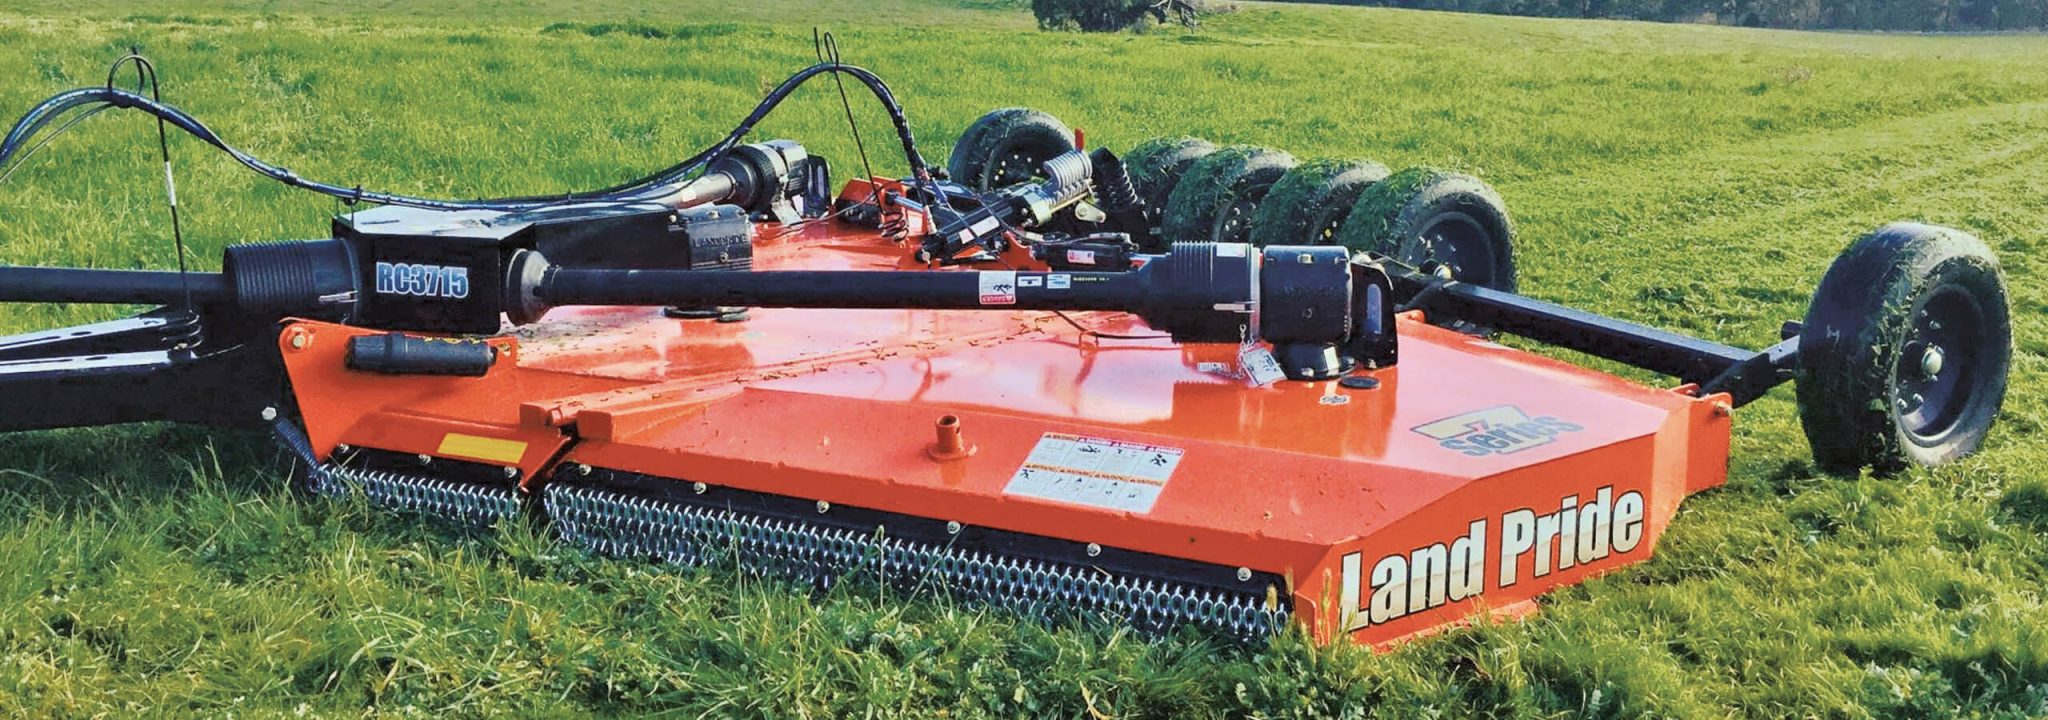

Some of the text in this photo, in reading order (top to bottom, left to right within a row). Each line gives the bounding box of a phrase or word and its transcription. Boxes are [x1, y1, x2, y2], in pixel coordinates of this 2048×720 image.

[376, 261, 469, 299] RC3715
[1438, 416, 1586, 457] series
[1340, 484, 1646, 632] Land Pride
